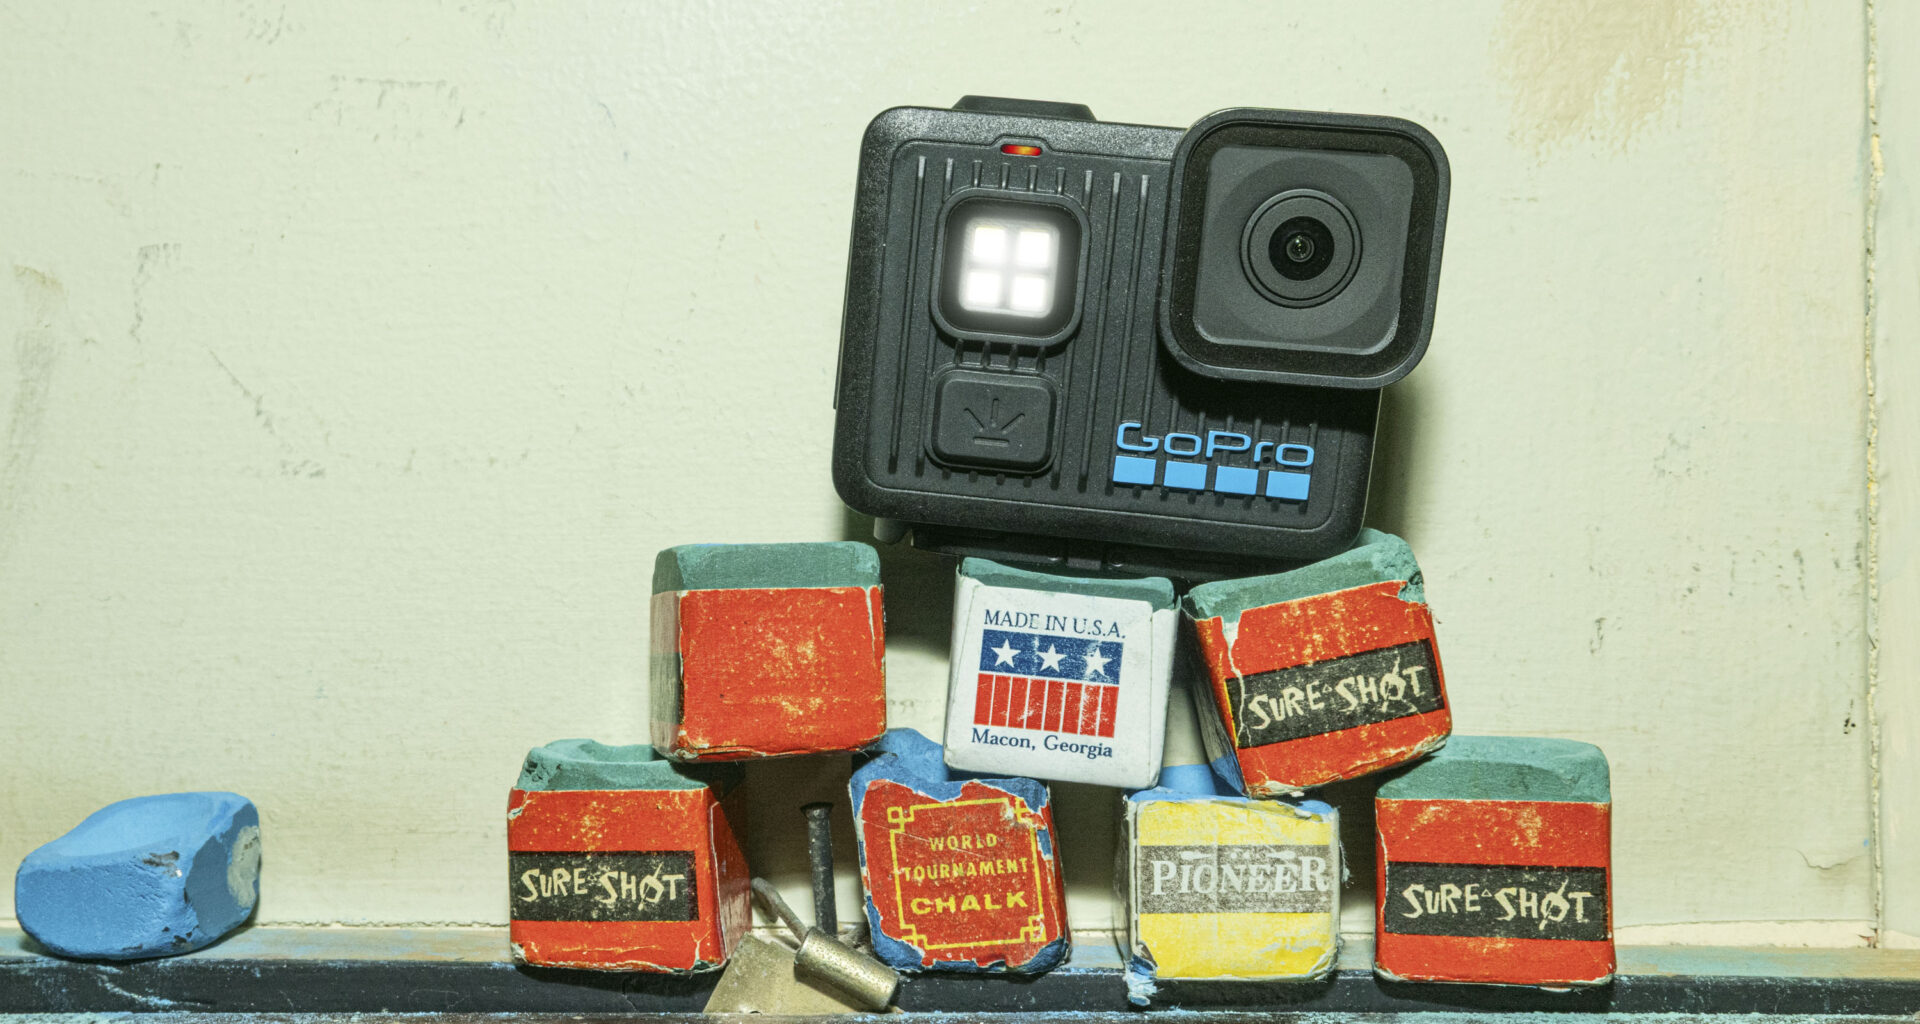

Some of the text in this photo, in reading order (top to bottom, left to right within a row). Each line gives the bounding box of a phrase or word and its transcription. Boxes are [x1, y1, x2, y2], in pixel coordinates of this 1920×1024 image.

[1116, 421, 1315, 467] GoPro
[983, 609, 1127, 639] MADE IN U.S.A.
[1249, 656, 1427, 730] SURE SHOT
[970, 727, 1113, 760] Macon, Georgia
[928, 833, 998, 852] WORLD
[518, 861, 685, 911] SURE SHOT
[903, 857, 1029, 882] TOURNAMENT
[1150, 855, 1330, 896] PIONEER
[910, 890, 1029, 915] CHALK
[1402, 876, 1595, 931] SURE SHOT
